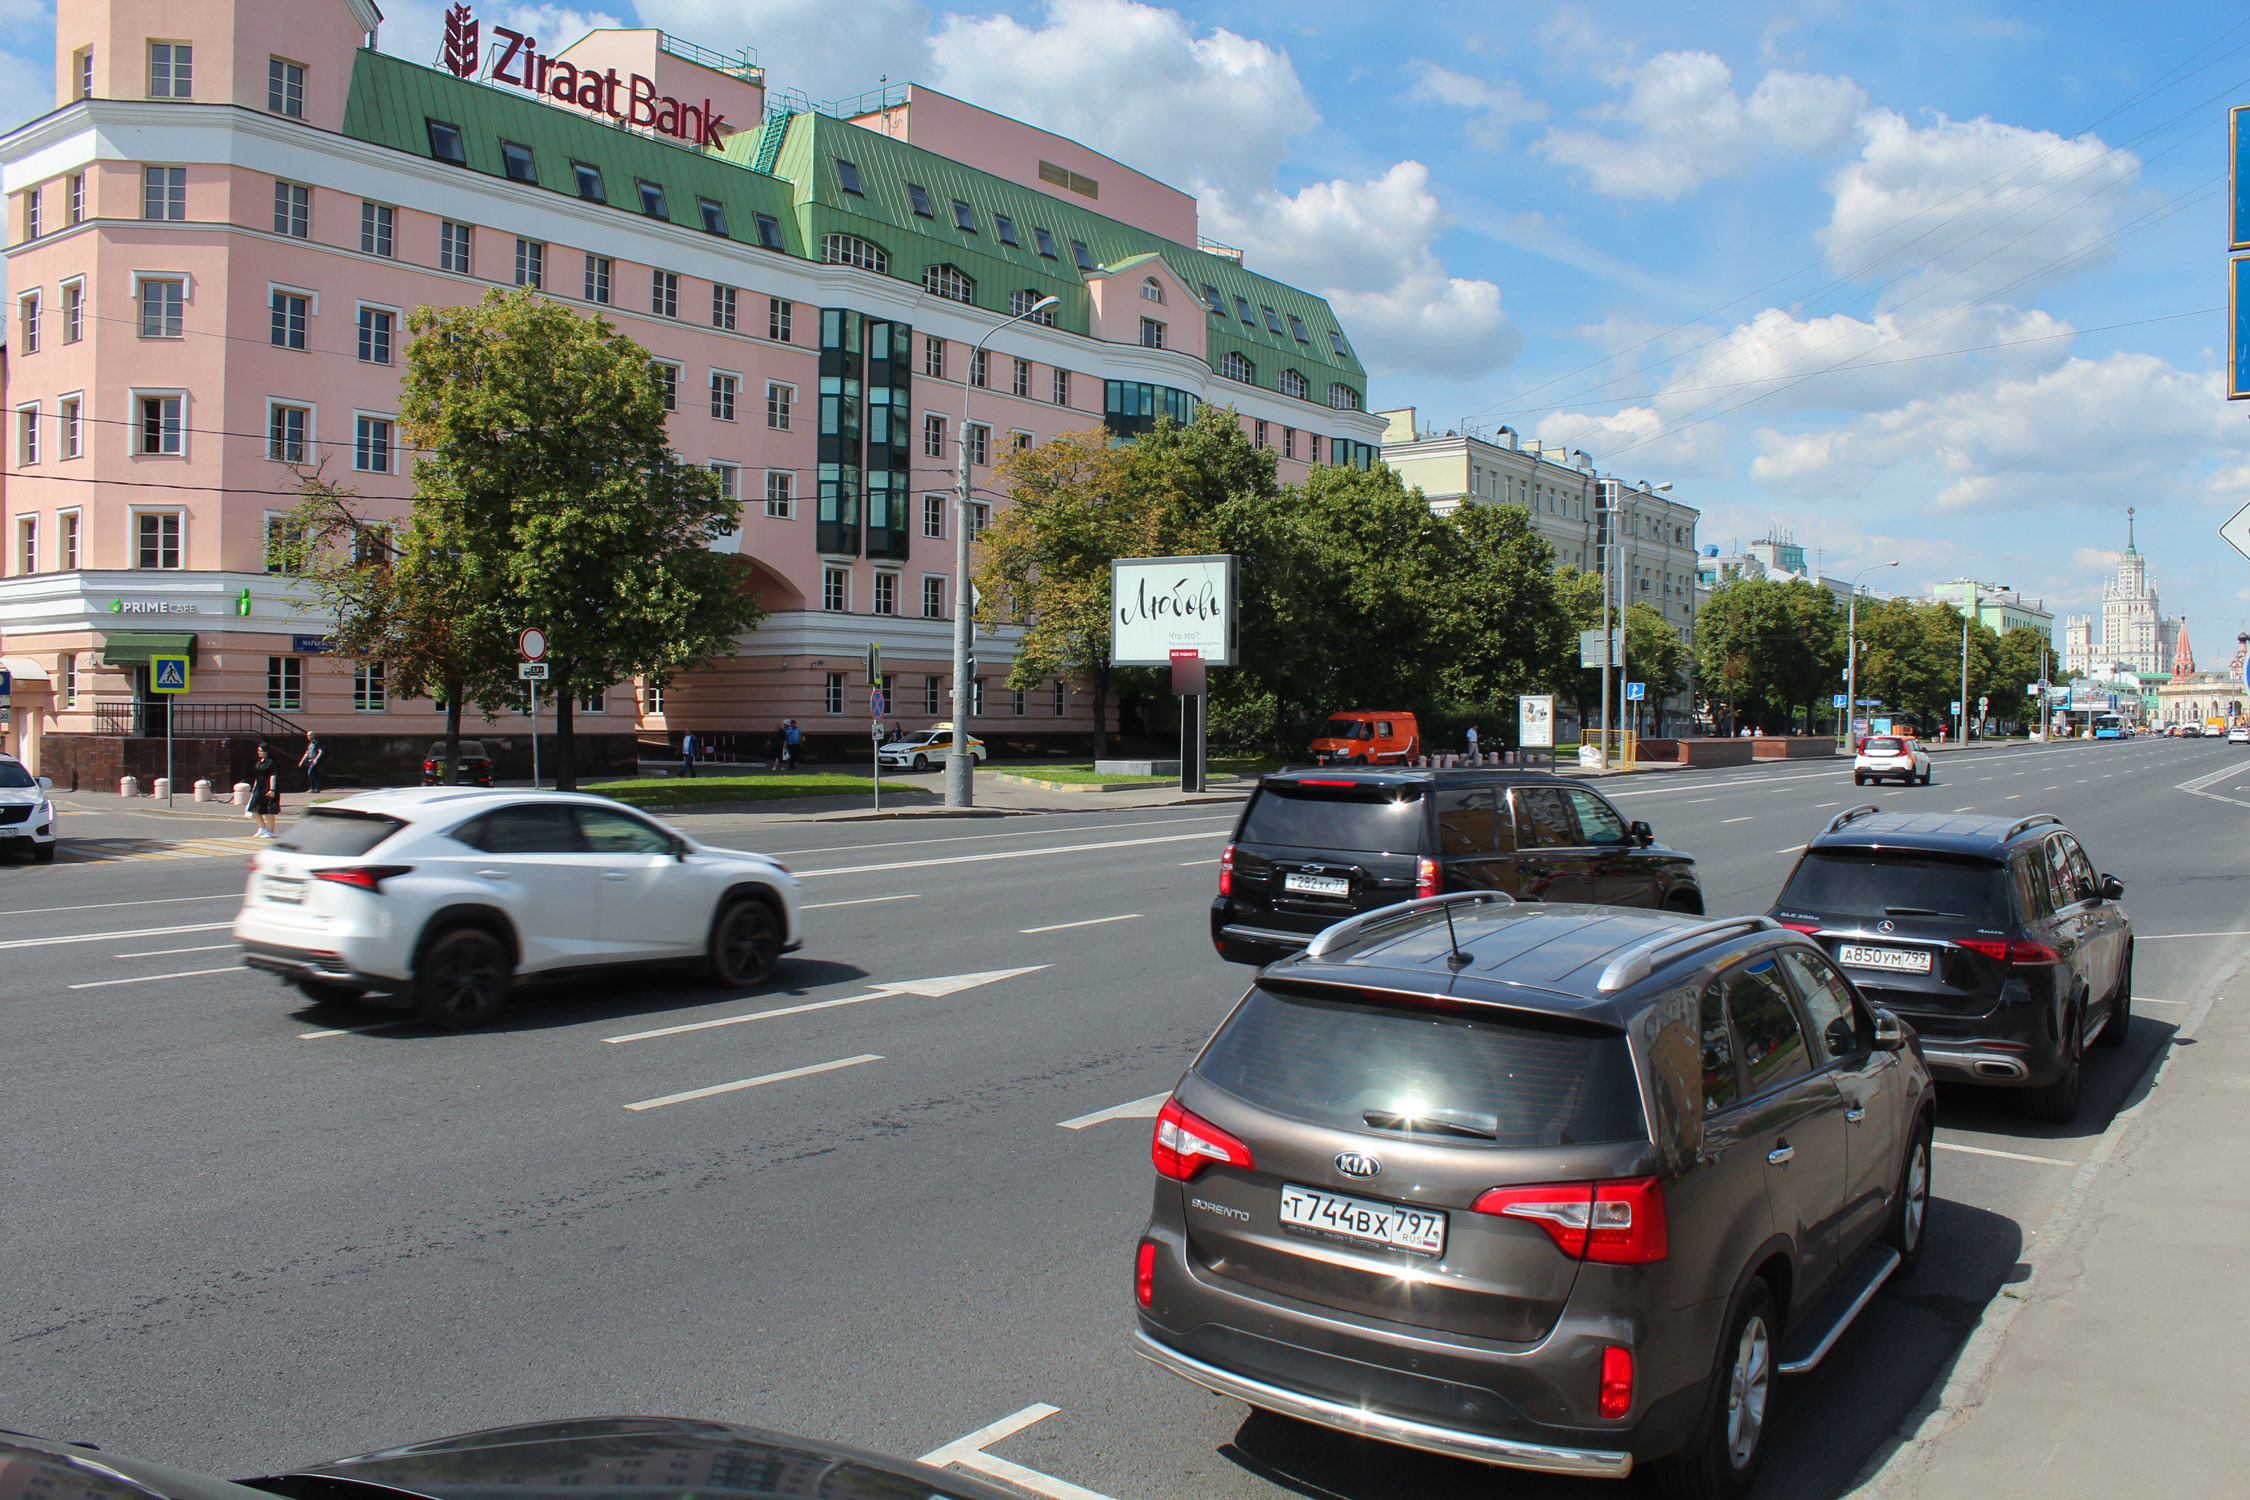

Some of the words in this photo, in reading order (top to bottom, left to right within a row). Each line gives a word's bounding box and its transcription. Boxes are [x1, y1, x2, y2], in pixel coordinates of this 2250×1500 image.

[123, 602, 168, 613] PRIME
[169, 604, 195, 613] CAFE
[1121, 577, 1220, 625] Любовь
[1169, 632, 1181, 640] Что
[1183, 632, 1200, 640] это?
[1844, 947, 1902, 965] А850УМ
[1904, 951, 1927, 963] 799
[1340, 1154, 1373, 1175] KIA
[1191, 1198, 1250, 1222] SORENTO
[1290, 1193, 1390, 1237] Т744ВХ
[1395, 1209, 1436, 1237] 797
[1402, 1233, 1423, 1245] RUS
